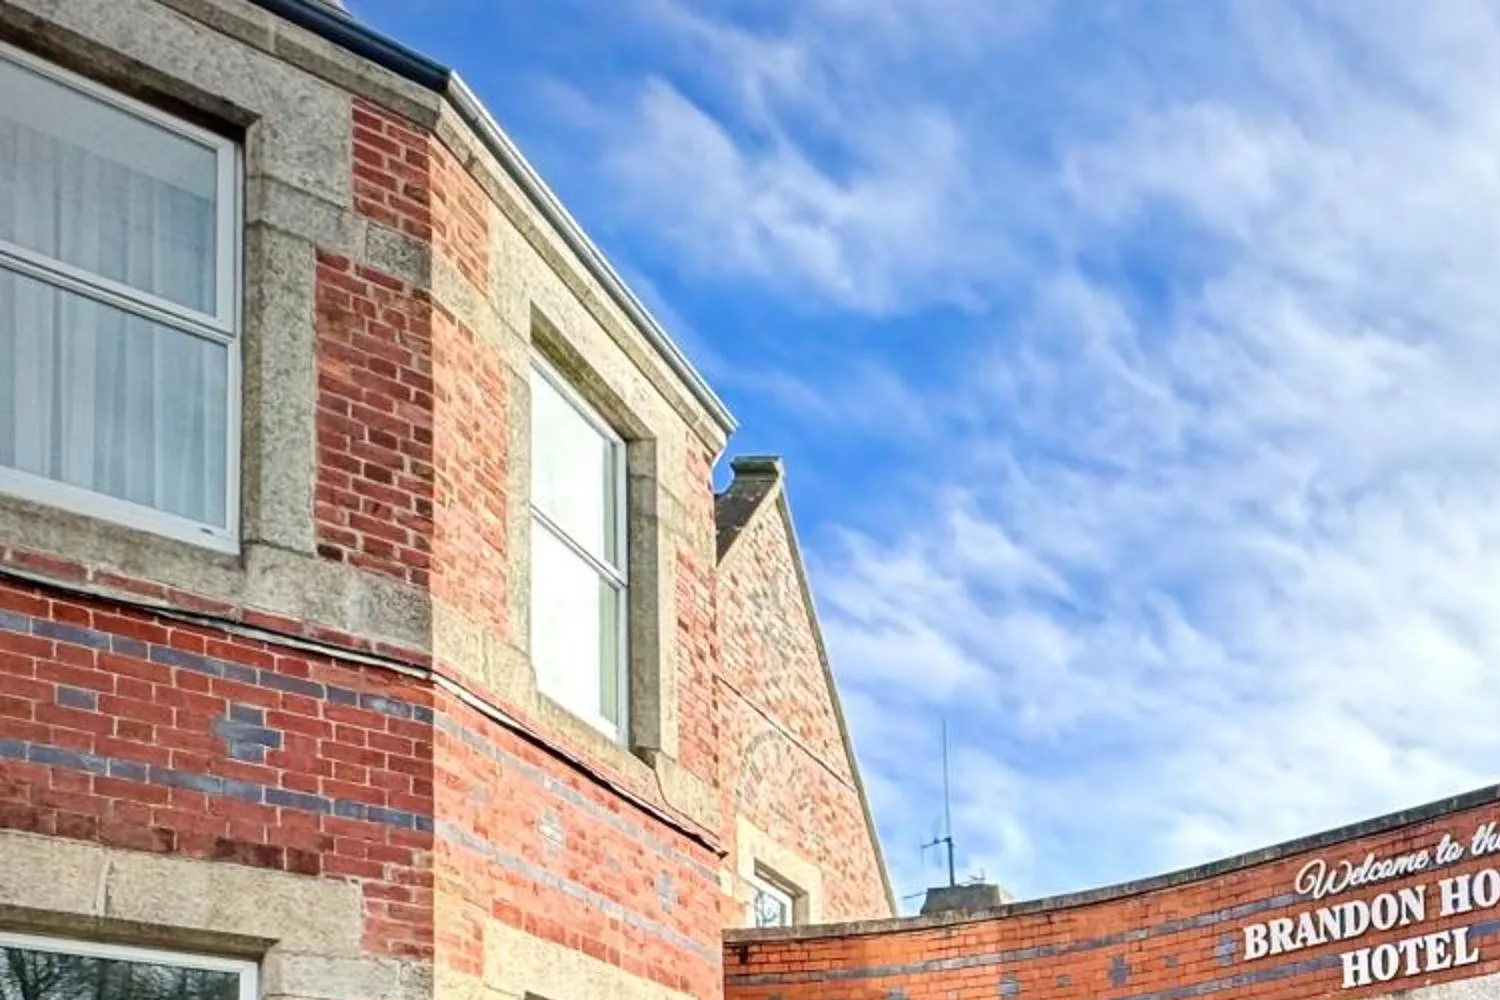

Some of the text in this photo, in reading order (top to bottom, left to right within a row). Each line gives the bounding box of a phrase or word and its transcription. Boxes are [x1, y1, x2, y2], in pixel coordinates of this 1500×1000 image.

[1295, 853, 1430, 899] Welcome
[1436, 834, 1465, 865] to
[1243, 885, 1427, 961] BRANDON
[1341, 927, 1480, 989] HOTEL
